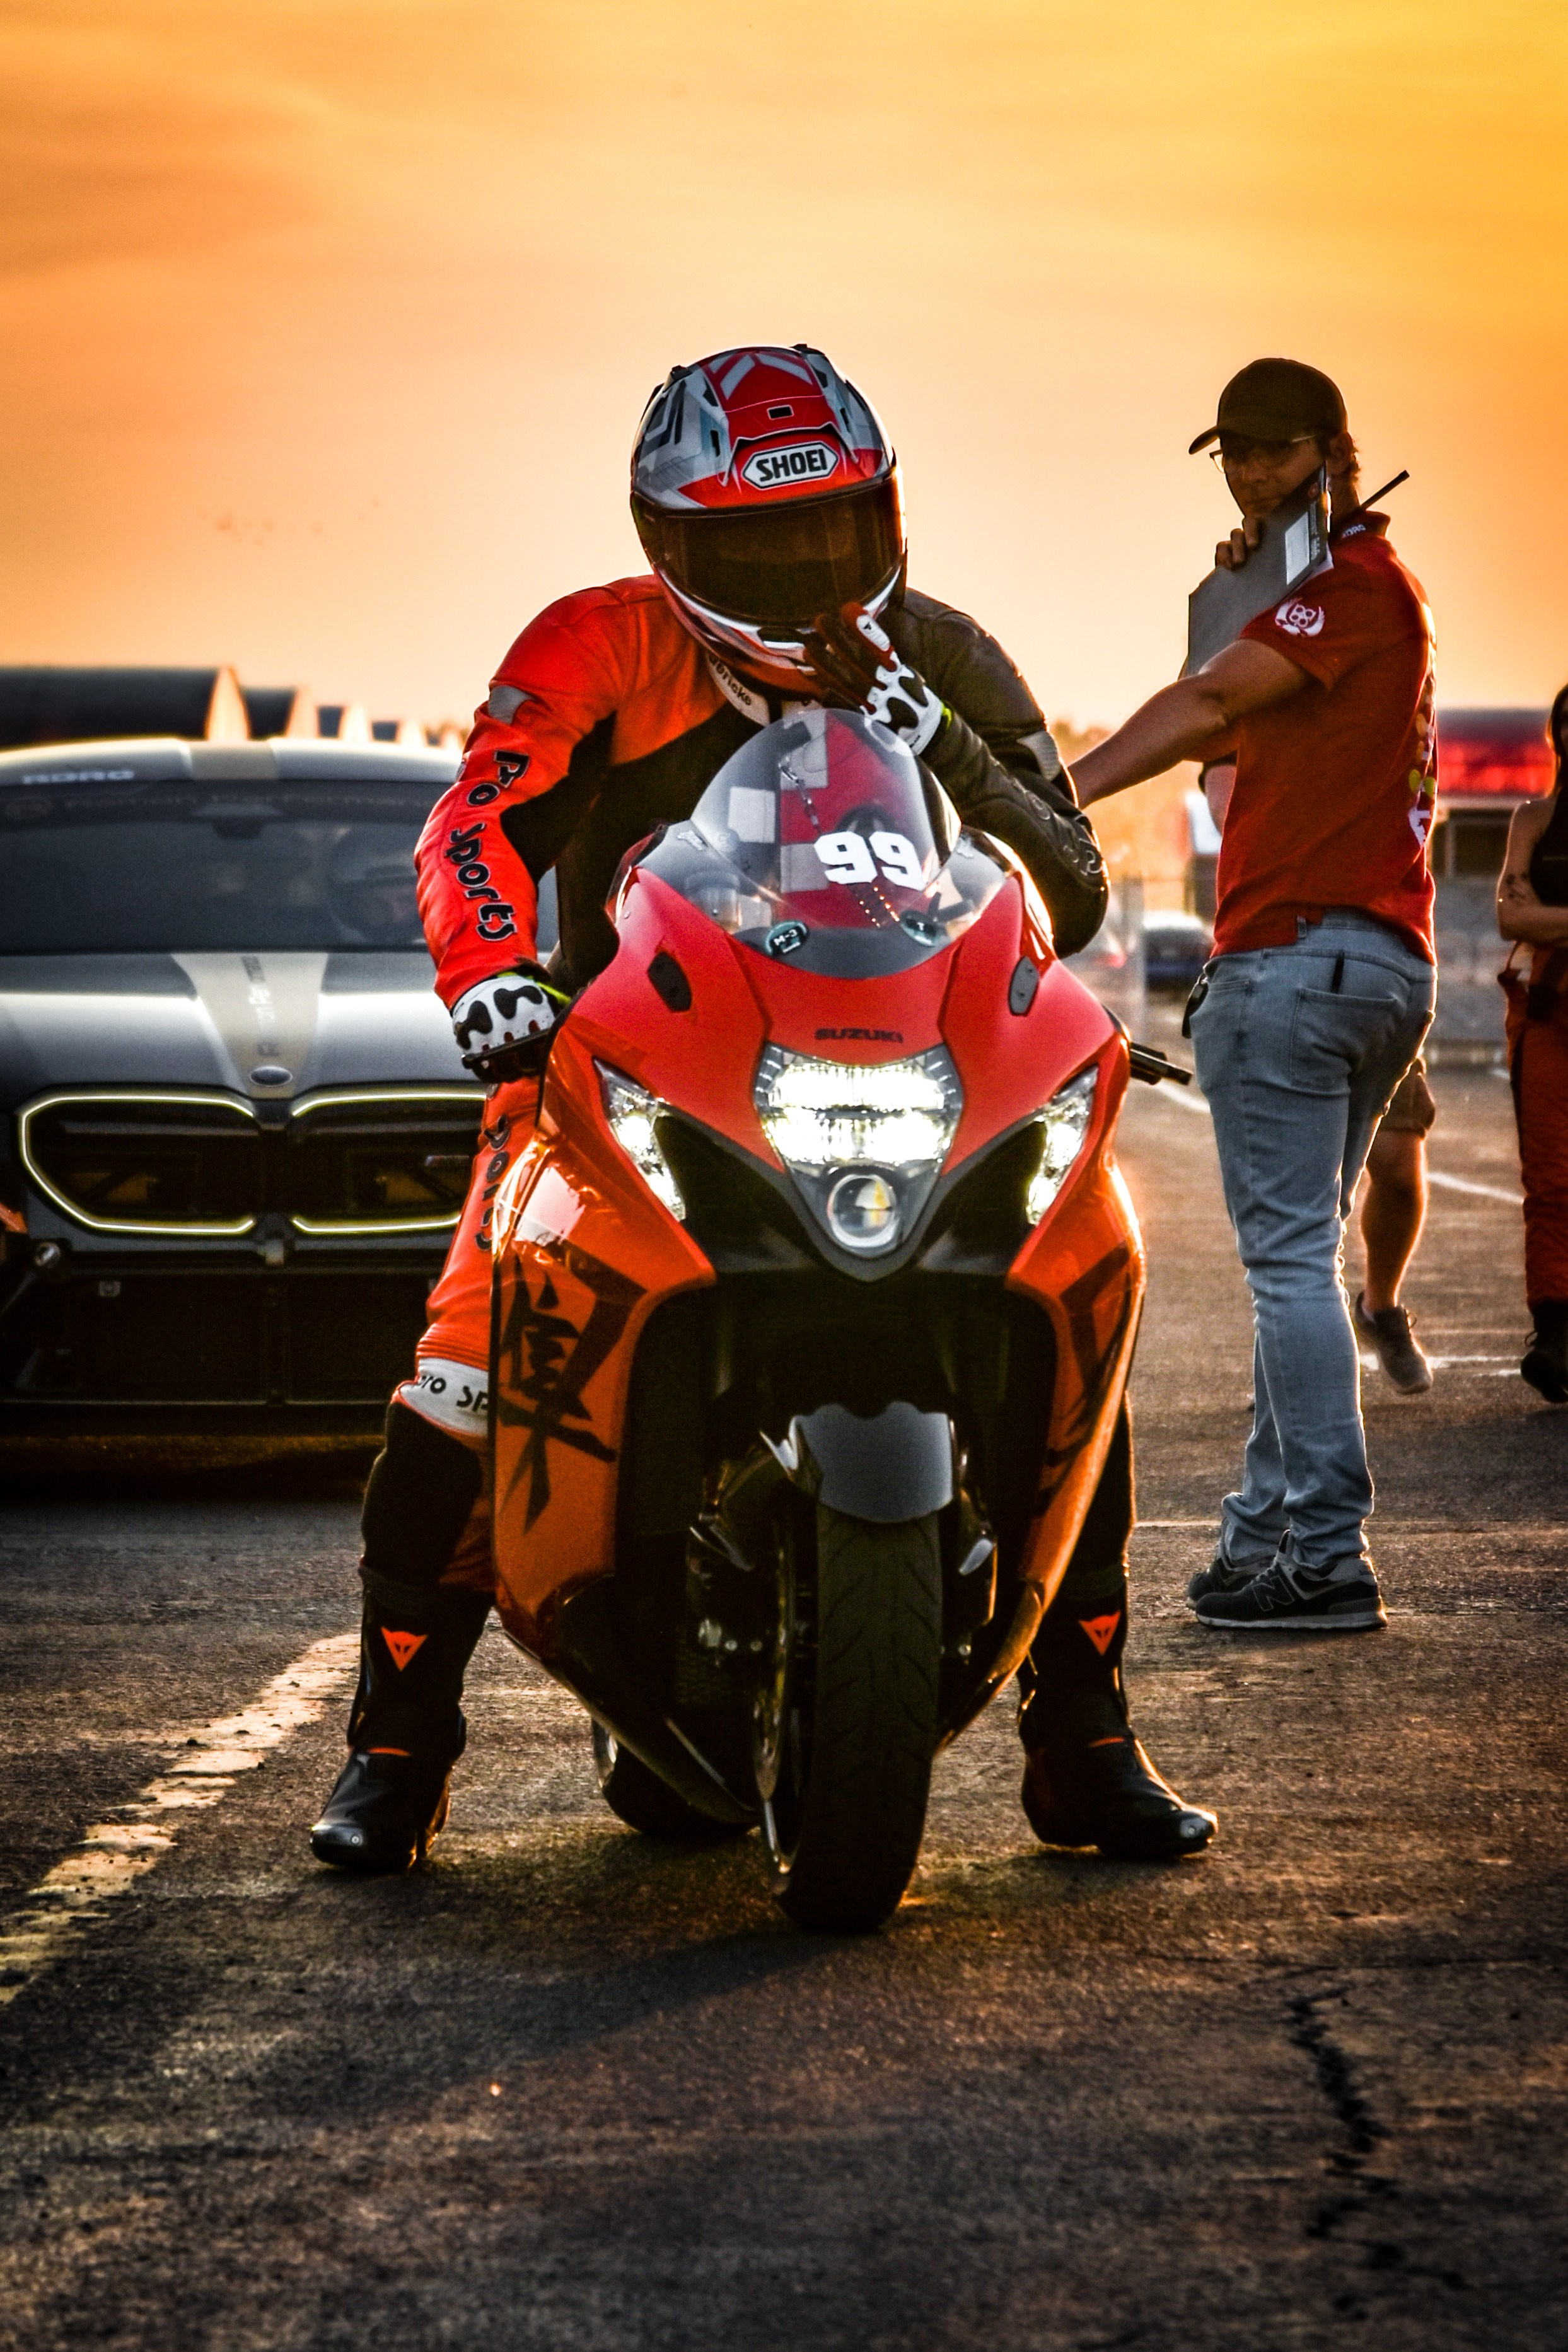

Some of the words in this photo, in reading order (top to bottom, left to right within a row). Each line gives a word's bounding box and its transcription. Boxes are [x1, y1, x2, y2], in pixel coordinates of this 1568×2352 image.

[756, 448, 827, 482] SHOEI
[813, 830, 927, 892] 99
[815, 1028, 903, 1044] SUZUKI
